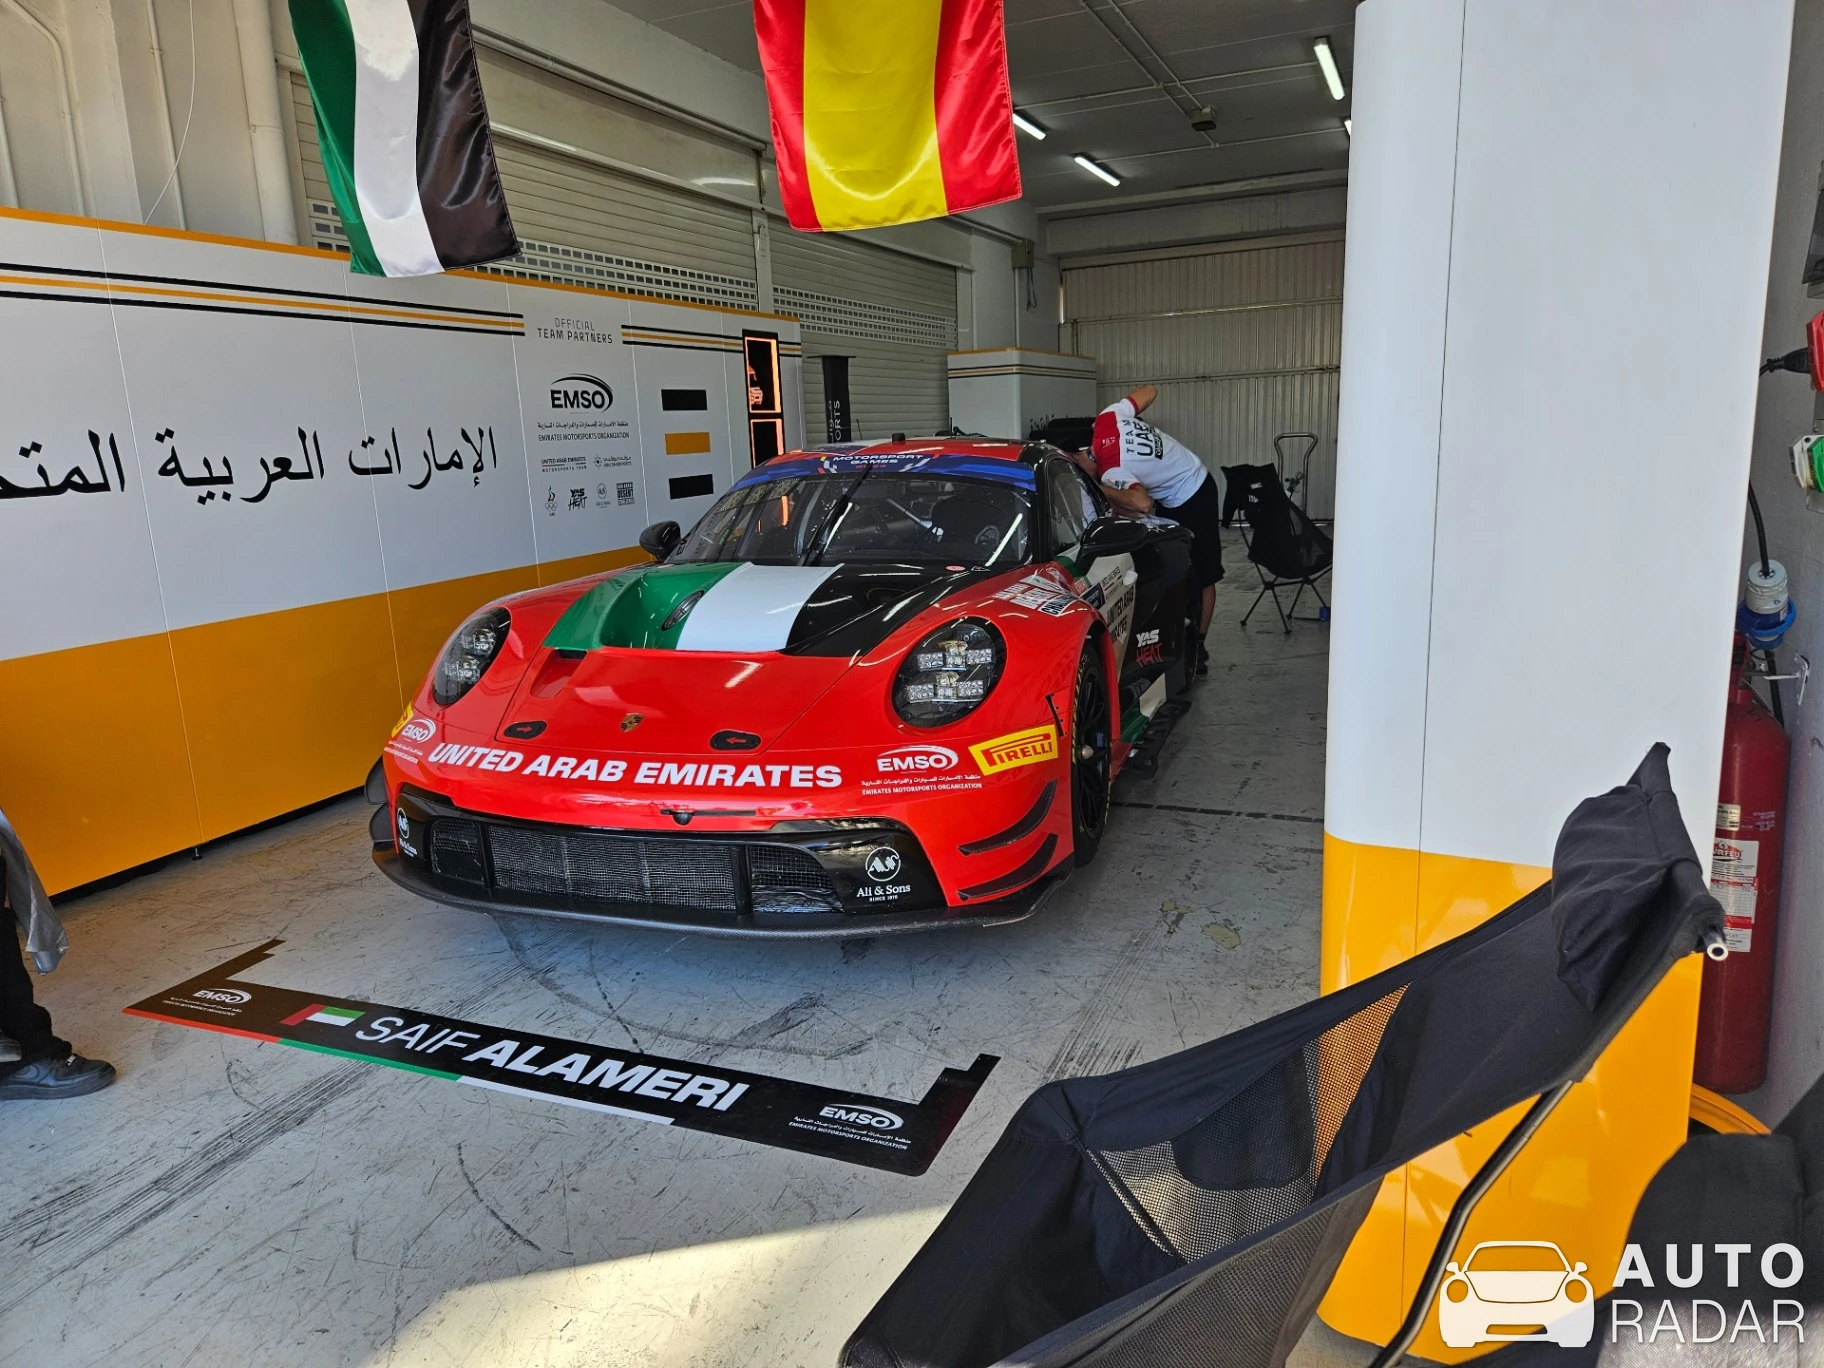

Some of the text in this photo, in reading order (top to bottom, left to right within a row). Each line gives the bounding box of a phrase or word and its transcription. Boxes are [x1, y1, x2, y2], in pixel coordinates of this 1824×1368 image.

[555, 317, 595, 332] OFFICIAL
[537, 328, 613, 344] TEAM PARTNERS
[550, 389, 606, 410] EMSO
[538, 431, 630, 442] EMIRATES MOTORSPORTS ORGANIZATION
[1121, 419, 1135, 454] TEAM
[1132, 421, 1154, 457] UAE
[155, 426, 326, 506] العربية
[348, 426, 498, 490] الإمارات
[832, 454, 924, 462] MOTORSPORT
[1136, 629, 1160, 648] YAS
[401, 724, 429, 741] EMSO
[980, 732, 1053, 767] PIRELLI
[427, 743, 524, 773] UNITED
[522, 755, 628, 782] ARAB
[634, 762, 843, 788] EMIRATES
[876, 754, 948, 772] EMSO
[862, 782, 982, 796] EMIRATES MOTORSPORTS ORGANIZATION
[856, 884, 911, 897] Ali & Sons
[192, 989, 241, 1003] EMSO
[355, 1016, 751, 1112] SAIF ALAMERI
[819, 1106, 891, 1128] EMSO
[788, 1121, 908, 1150] EMIRATES MOTORSPORTS ORGANIZATION
